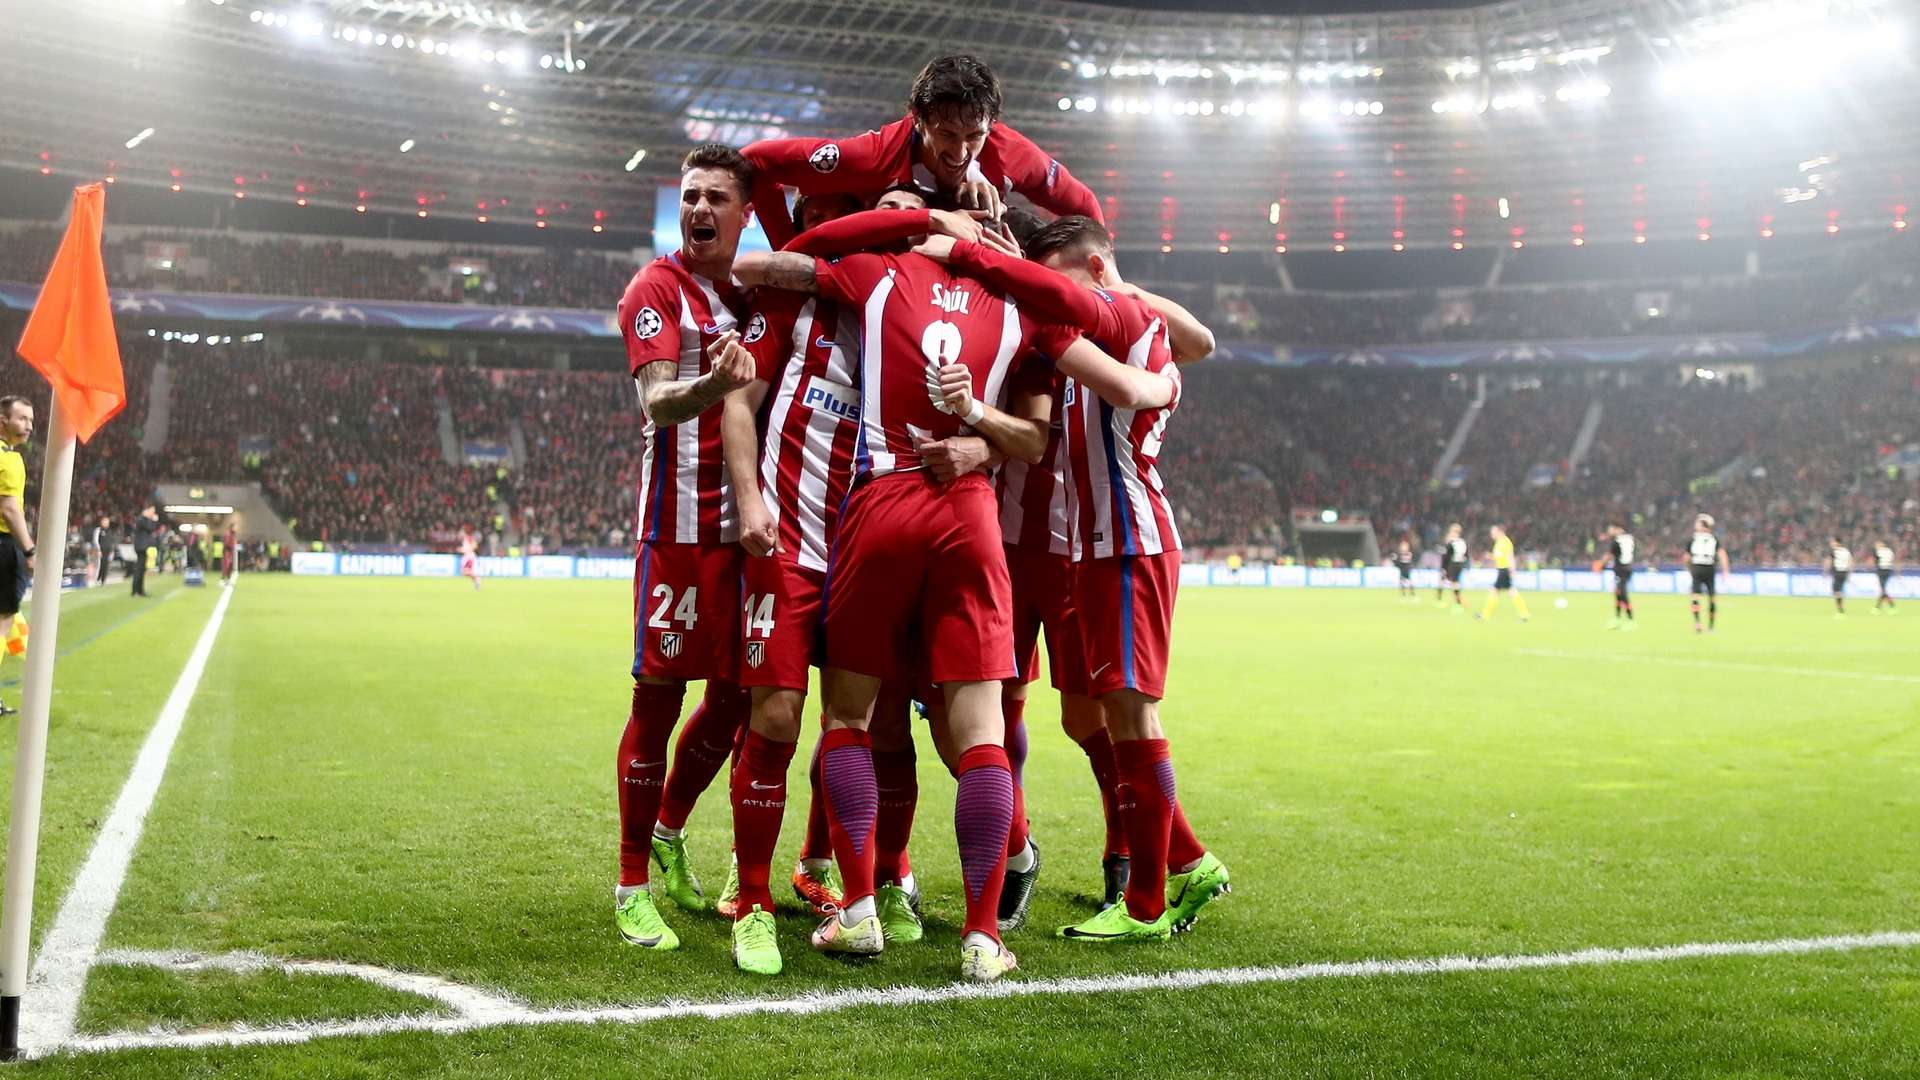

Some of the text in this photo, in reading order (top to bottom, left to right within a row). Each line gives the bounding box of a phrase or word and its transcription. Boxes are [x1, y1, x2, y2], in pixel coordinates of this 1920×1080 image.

[806, 386, 861, 421] Plus
[648, 583, 698, 630] 24
[745, 593, 776, 639] 14
